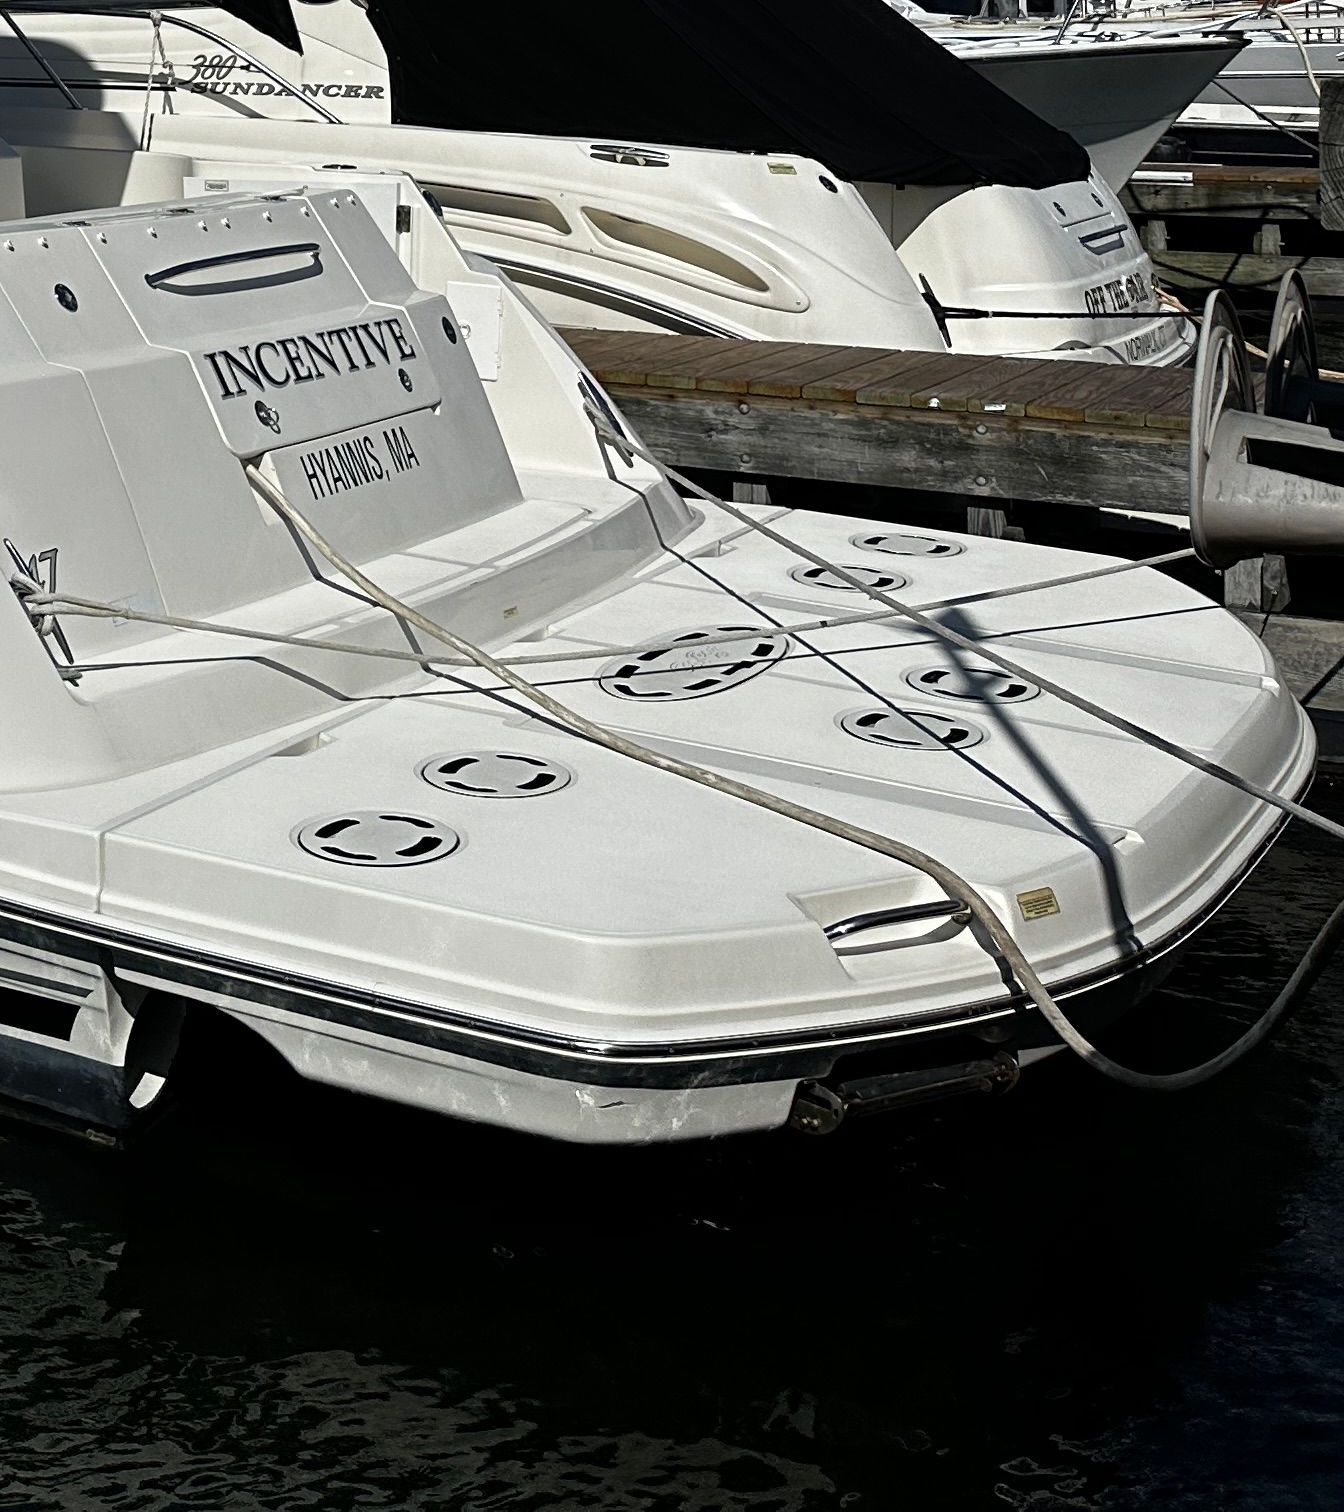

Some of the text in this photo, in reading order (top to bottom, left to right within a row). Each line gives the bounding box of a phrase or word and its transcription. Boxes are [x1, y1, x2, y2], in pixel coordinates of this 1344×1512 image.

[184, 54, 238, 85] 380
[191, 81, 385, 99] SUNDANCER
[1085, 286, 1107, 314] OFF
[204, 318, 416, 400] INCENTIVE
[300, 426, 420, 501] HYANNIS, MA
